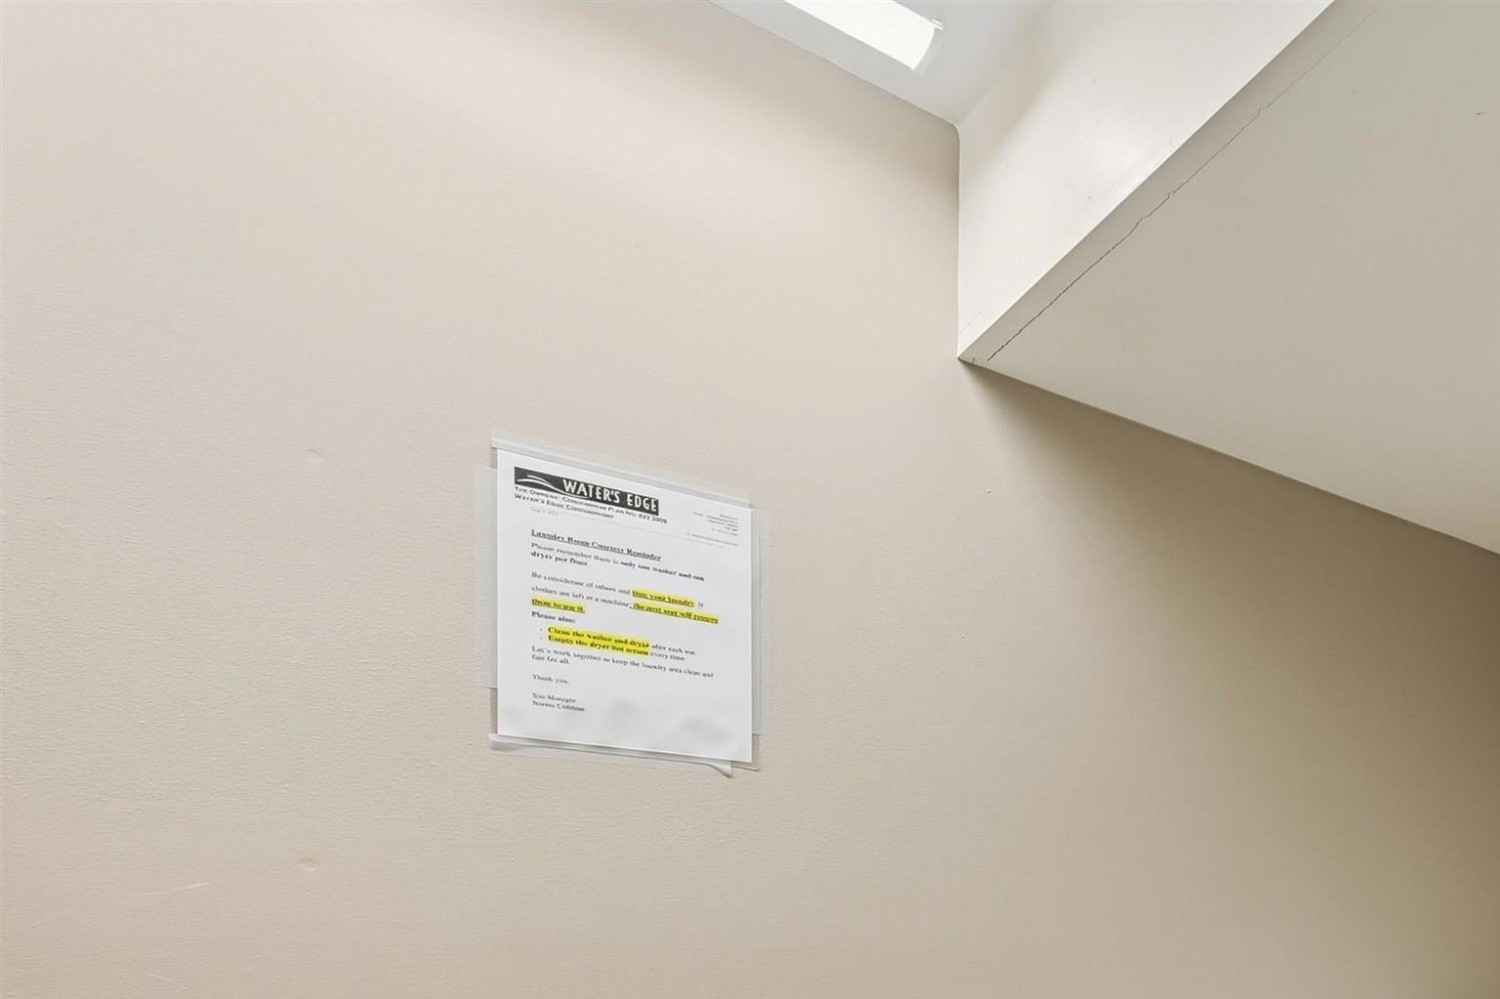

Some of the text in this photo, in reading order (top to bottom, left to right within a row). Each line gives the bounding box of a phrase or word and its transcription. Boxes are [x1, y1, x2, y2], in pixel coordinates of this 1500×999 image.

[562, 479, 620, 503] WATER'S
[626, 490, 657, 512] EDGE
[548, 627, 570, 636] Clean
